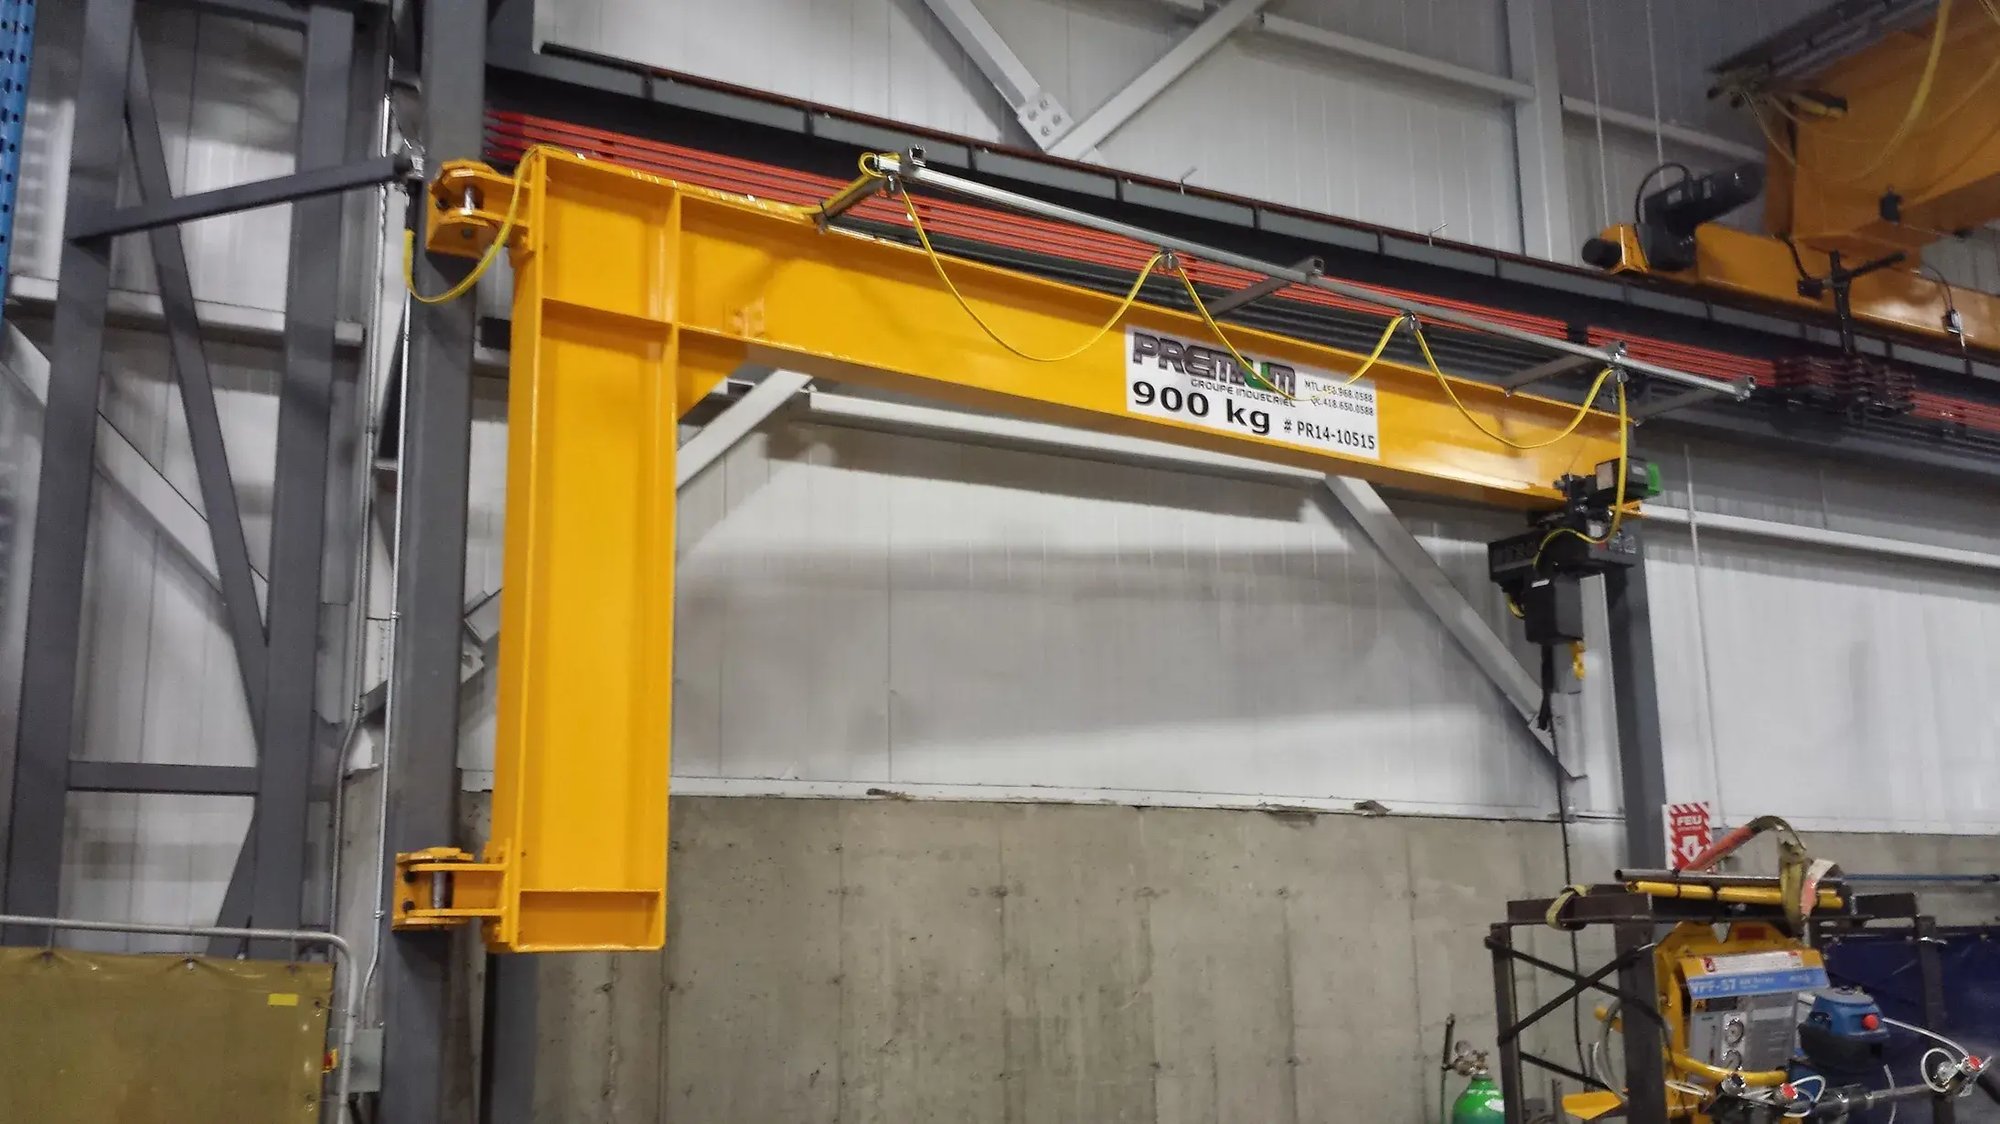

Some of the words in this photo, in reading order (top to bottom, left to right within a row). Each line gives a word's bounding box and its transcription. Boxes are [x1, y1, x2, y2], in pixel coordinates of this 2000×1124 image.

[1190, 378, 1233, 395] GROUPE
[1133, 381, 1209, 417] 900
[1226, 398, 1270, 435] kg
[1283, 419, 1292, 433] #
[1297, 420, 1375, 450] PR14-10515
